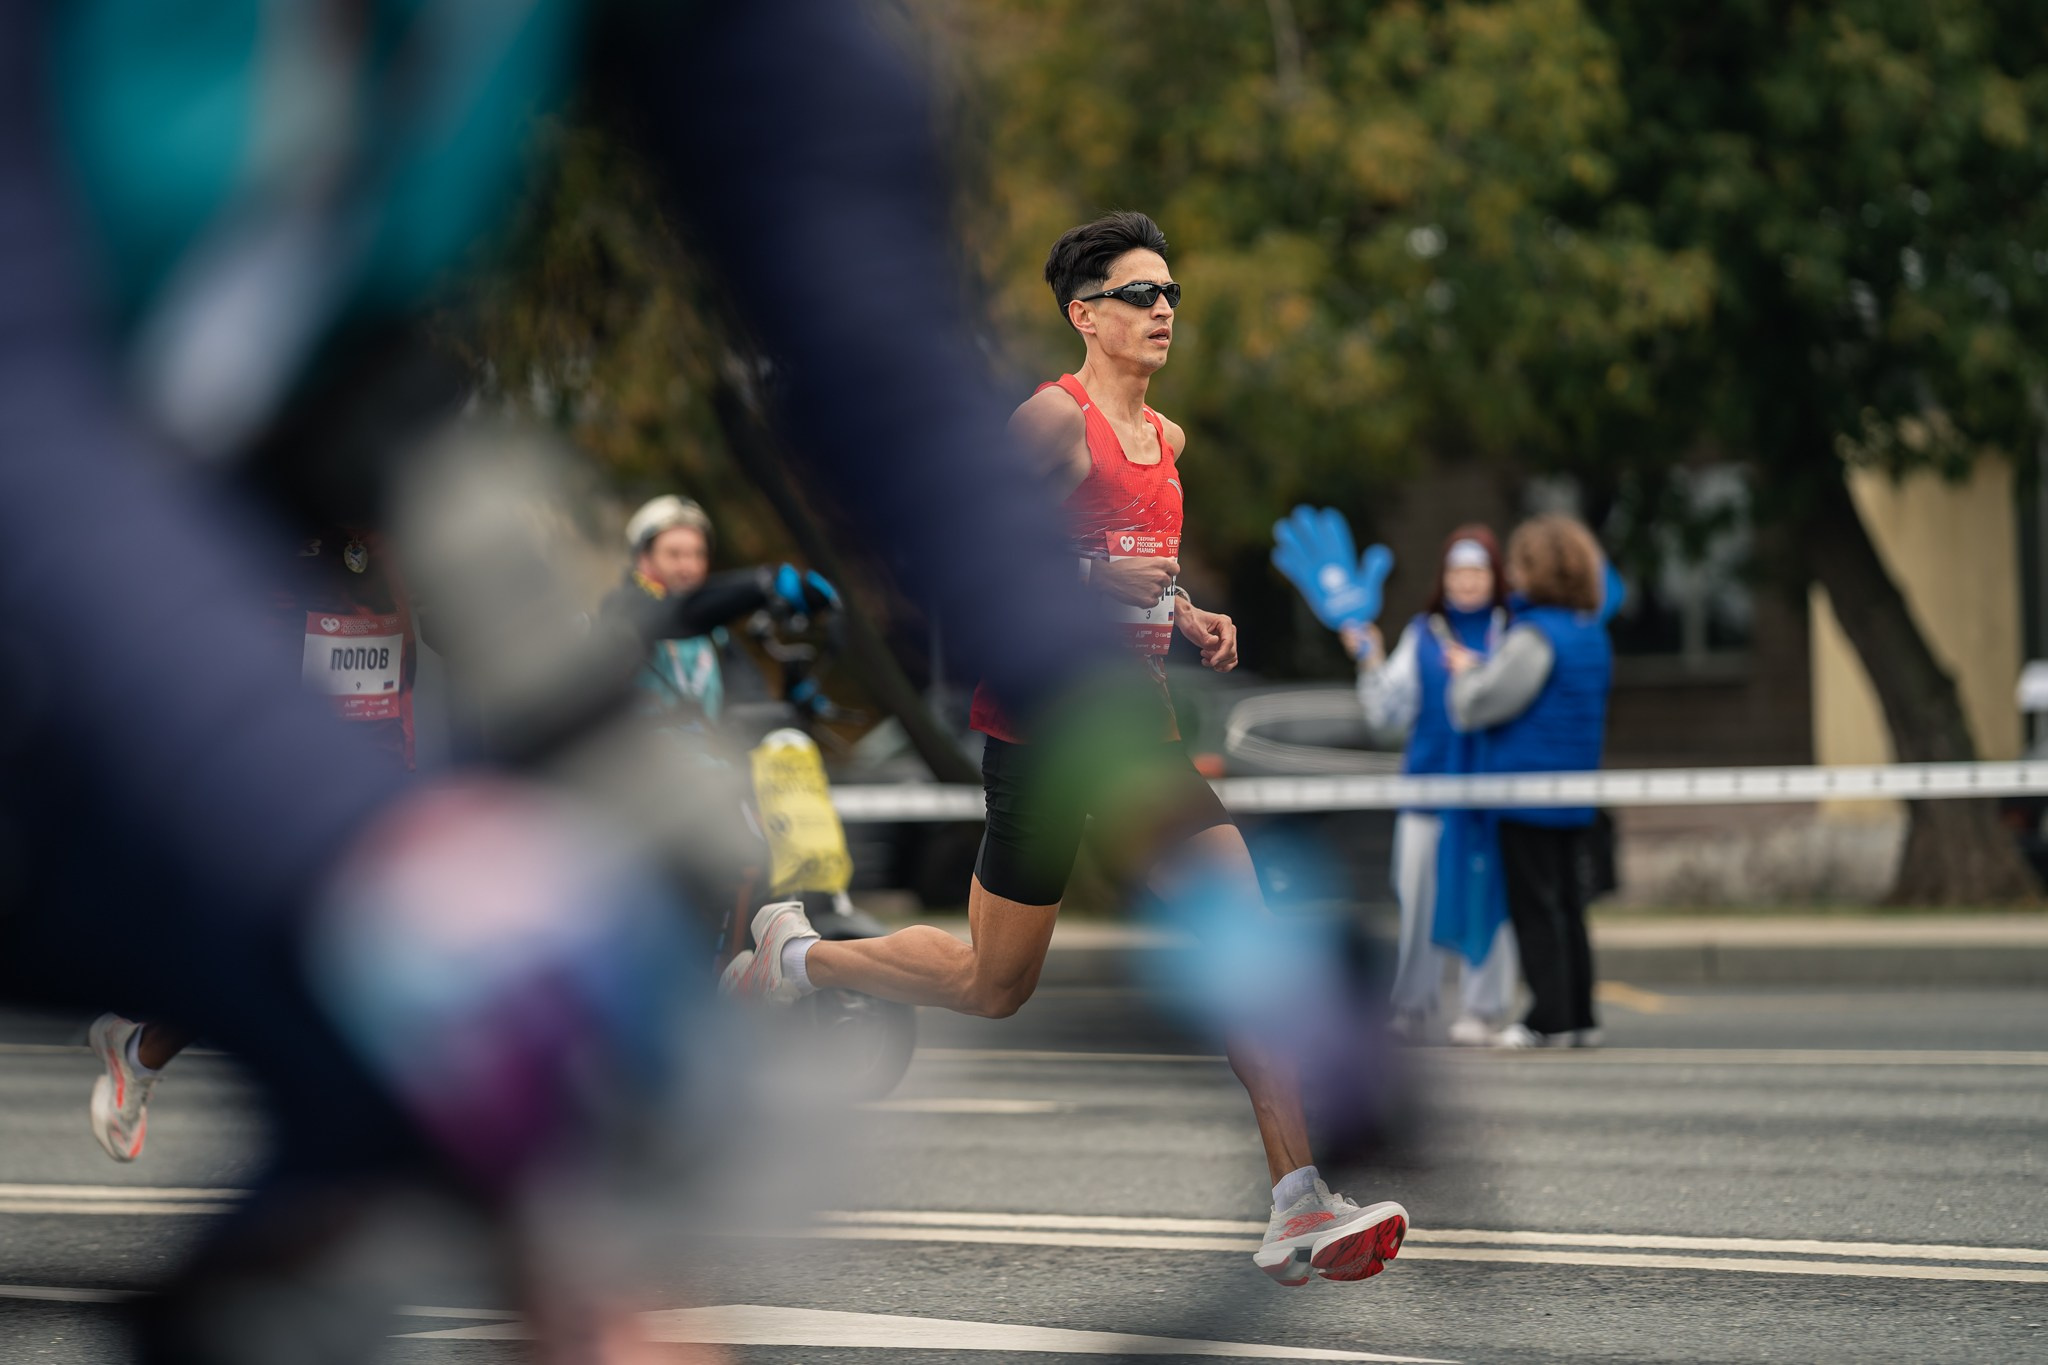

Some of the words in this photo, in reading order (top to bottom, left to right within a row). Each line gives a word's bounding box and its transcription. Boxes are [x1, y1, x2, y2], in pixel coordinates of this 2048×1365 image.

[1146, 610, 1151, 619] 3
[331, 648, 389, 670] ПОПОВ
[356, 682, 361, 690] 9
